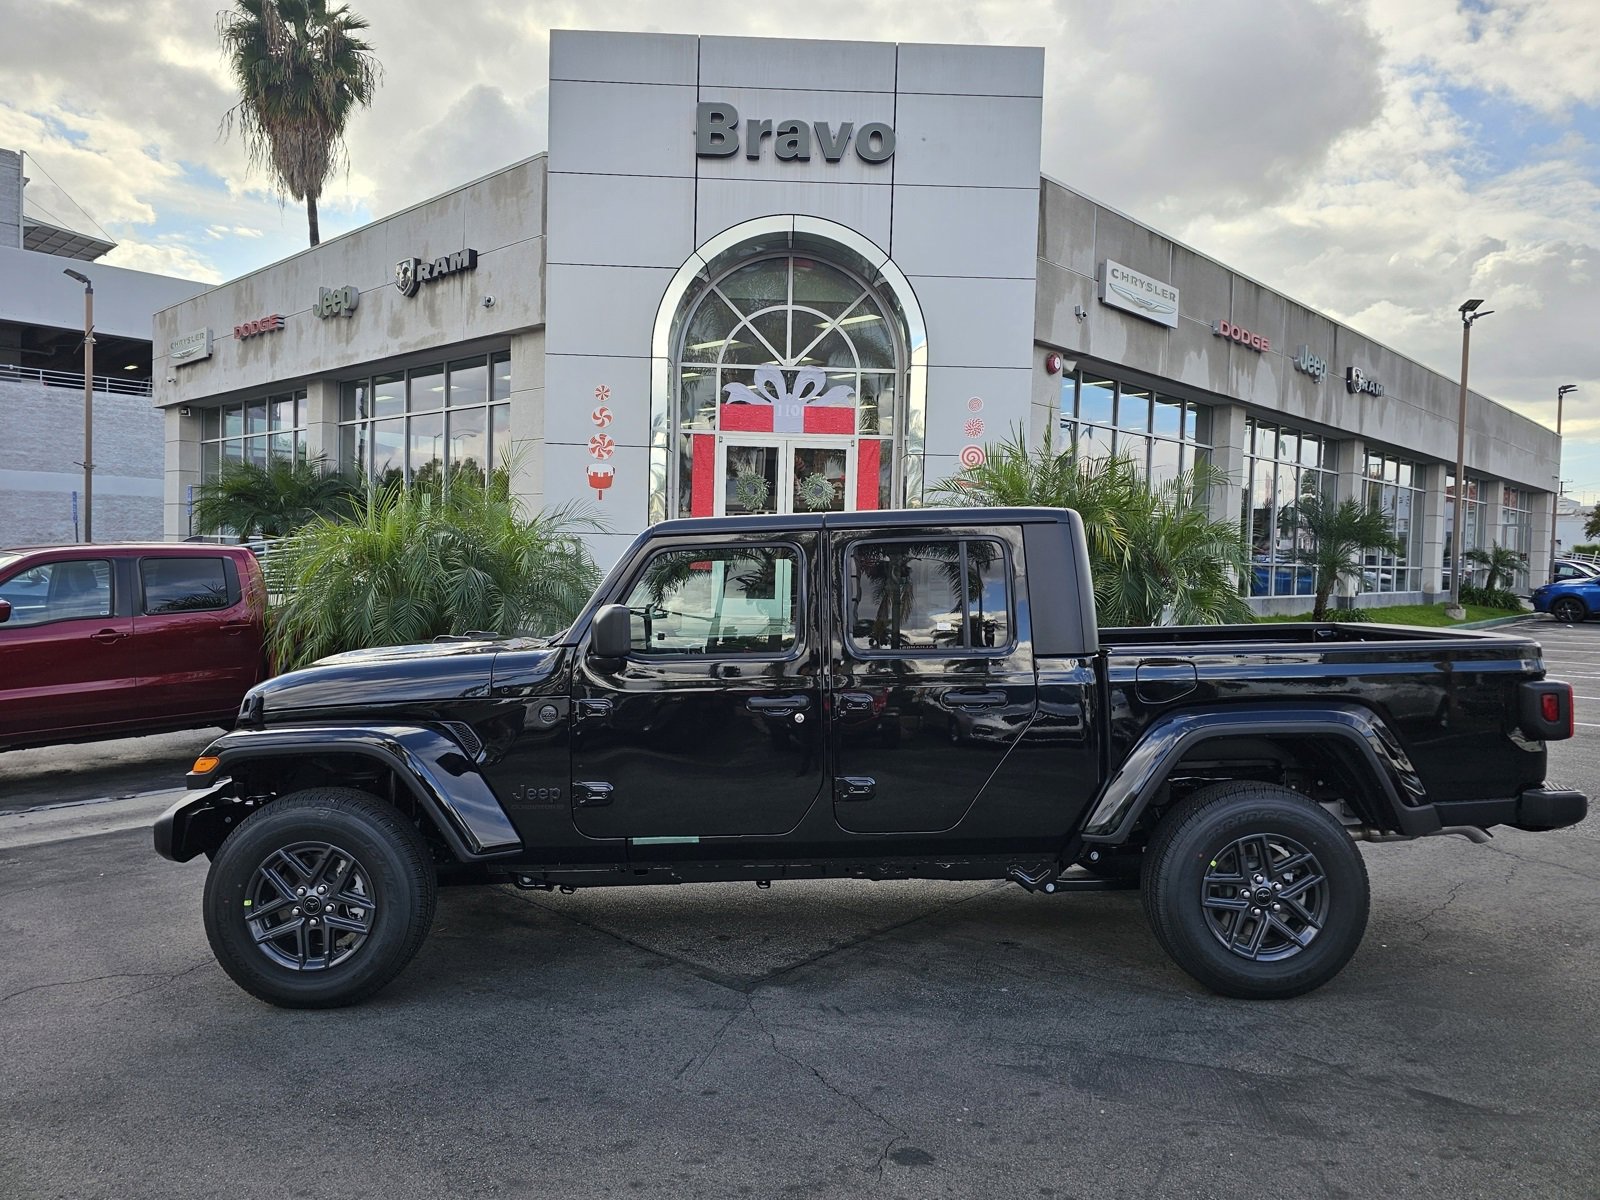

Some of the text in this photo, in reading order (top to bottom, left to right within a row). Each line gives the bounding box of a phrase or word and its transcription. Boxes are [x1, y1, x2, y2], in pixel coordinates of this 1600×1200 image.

[696, 101, 896, 164] Bravo
[416, 249, 475, 283] RAM
[1110, 267, 1177, 303] CHRYSLER
[313, 285, 355, 319] Jeep
[169, 332, 206, 350] CHRYSLER
[233, 314, 281, 340] DODGE
[1218, 319, 1270, 352] DODGE
[1299, 344, 1328, 384] Jeep
[1361, 378, 1385, 397] RAM
[512, 784, 561, 804] Jeep
